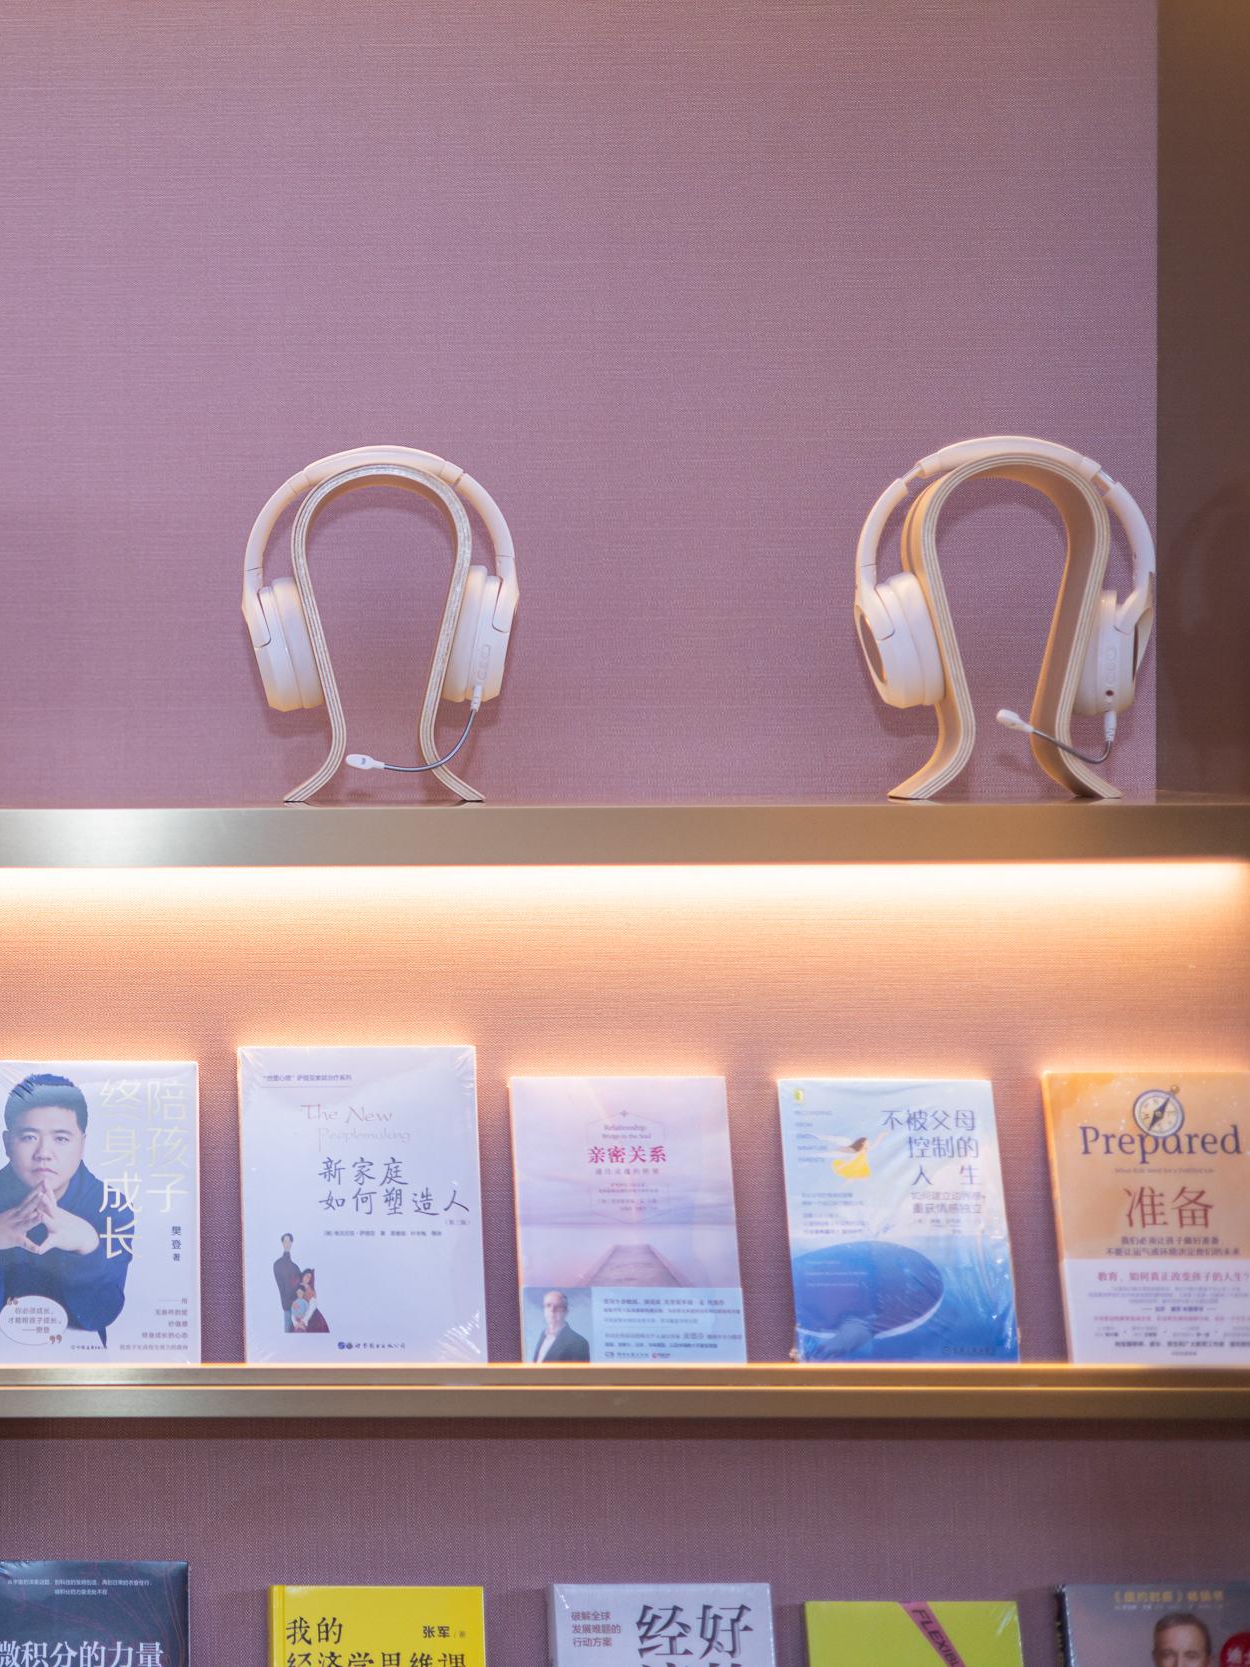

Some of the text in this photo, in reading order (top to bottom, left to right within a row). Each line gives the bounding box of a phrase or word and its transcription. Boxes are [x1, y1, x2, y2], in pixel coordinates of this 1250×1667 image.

[301, 1103, 393, 1124] The New
[881, 1109, 975, 1132] 不被父母
[145, 1080, 190, 1214] 陪孩子
[588, 1145, 667, 1164] 亲密关系
[907, 1136, 979, 1159] 控制的
[1079, 1124, 1243, 1164] Prepared
[99, 1078, 143, 1260] 终身成长
[318, 1156, 409, 1187] 新家庭
[911, 1165, 983, 1186] 人生
[318, 1187, 469, 1216] 如何塑造人
[1123, 1186, 1214, 1229] 准备
[571, 1611, 611, 1621] 破解全球
[285, 1616, 343, 1645] 我的
[572, 1623, 622, 1635] 发展难题的
[573, 1637, 613, 1648] 行动方案
